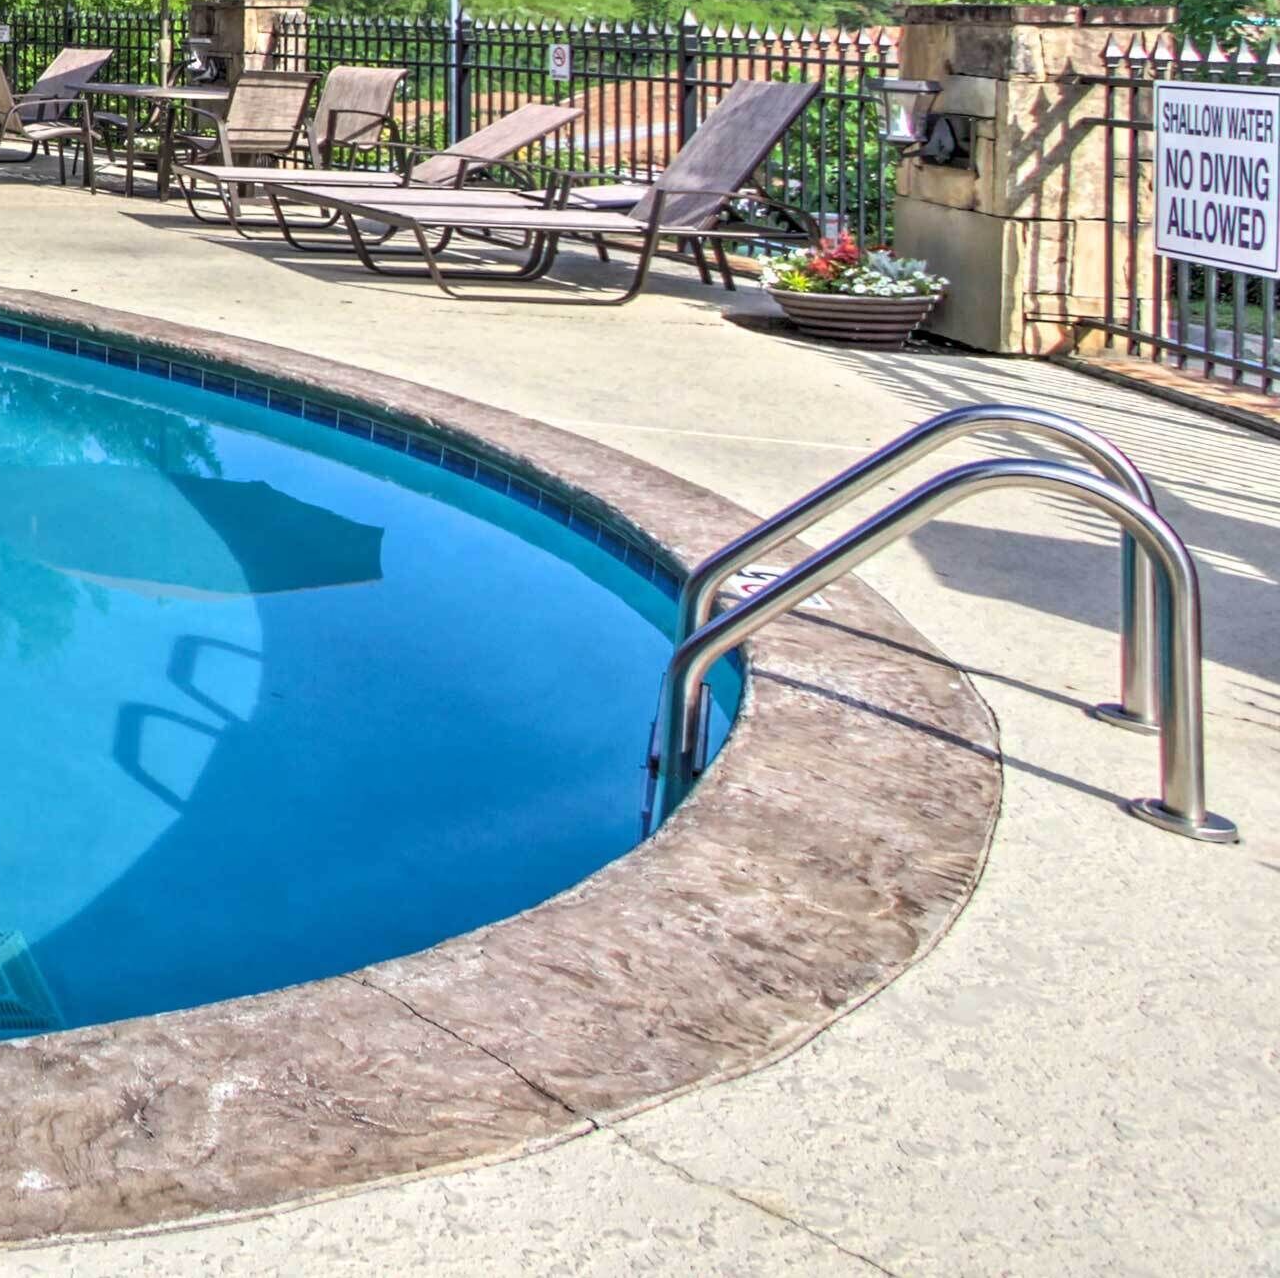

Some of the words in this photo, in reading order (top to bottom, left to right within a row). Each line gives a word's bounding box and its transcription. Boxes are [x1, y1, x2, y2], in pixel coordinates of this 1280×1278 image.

[1162, 102, 1224, 139] SHALLOW
[1225, 108, 1273, 144] WATER
[1166, 148, 1193, 190] NO
[1200, 152, 1270, 202] DIVING
[1167, 196, 1266, 251] ALLOWED
